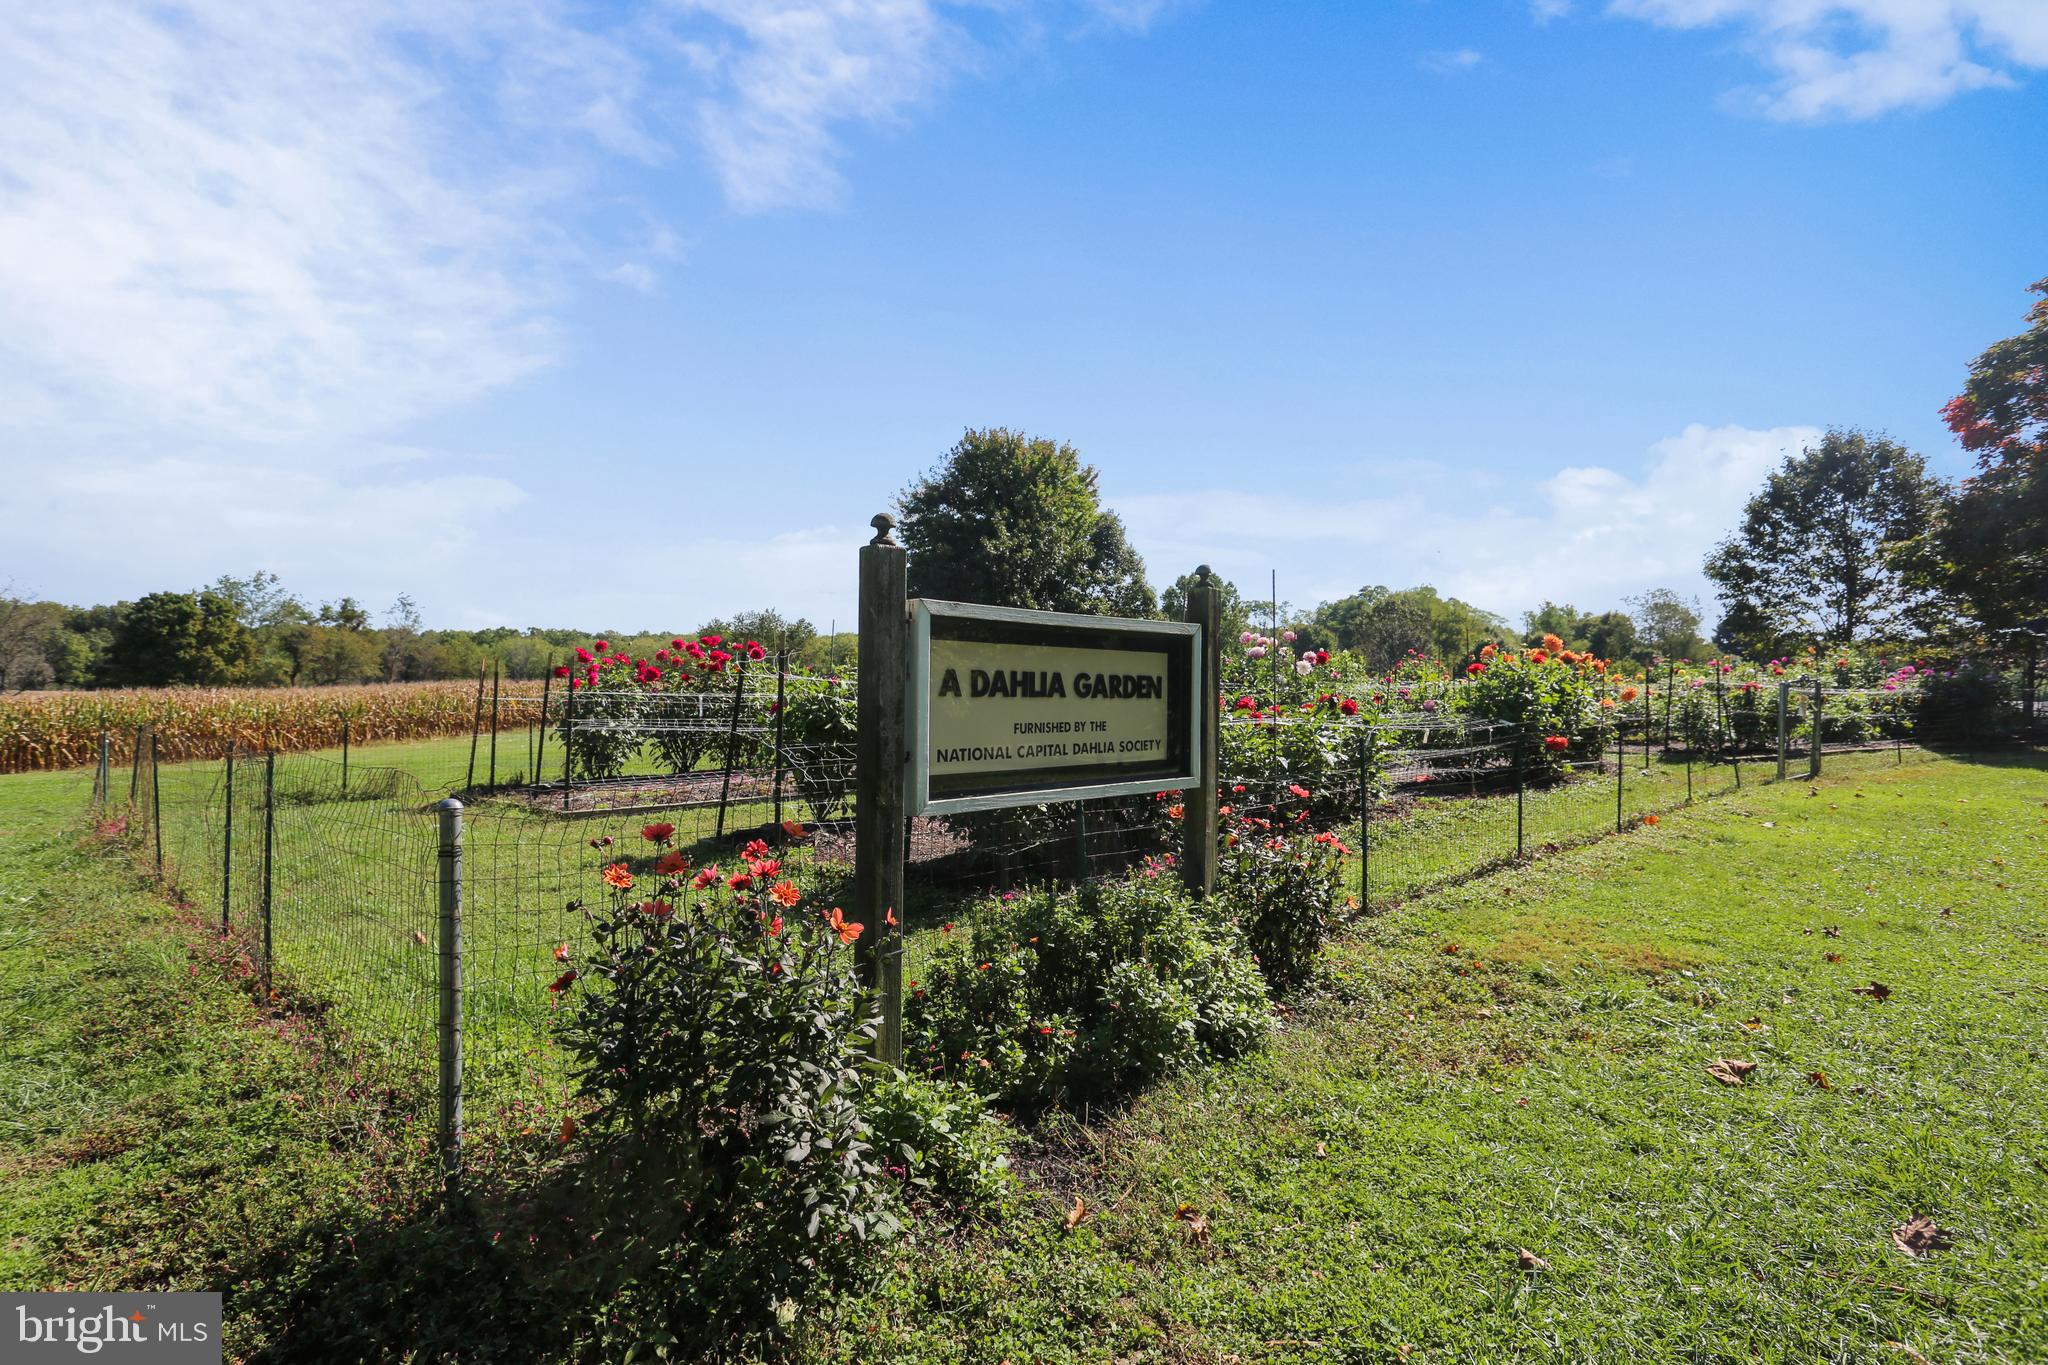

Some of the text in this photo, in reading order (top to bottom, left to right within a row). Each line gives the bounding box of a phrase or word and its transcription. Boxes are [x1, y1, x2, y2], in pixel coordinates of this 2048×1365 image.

[938, 668, 1163, 699] A DAHLIA GARDEN
[1013, 720, 1107, 735] FURNISHED BY THE
[936, 739, 1162, 763] NATIONAL CAPITAL DAHLIA SOCIETY
